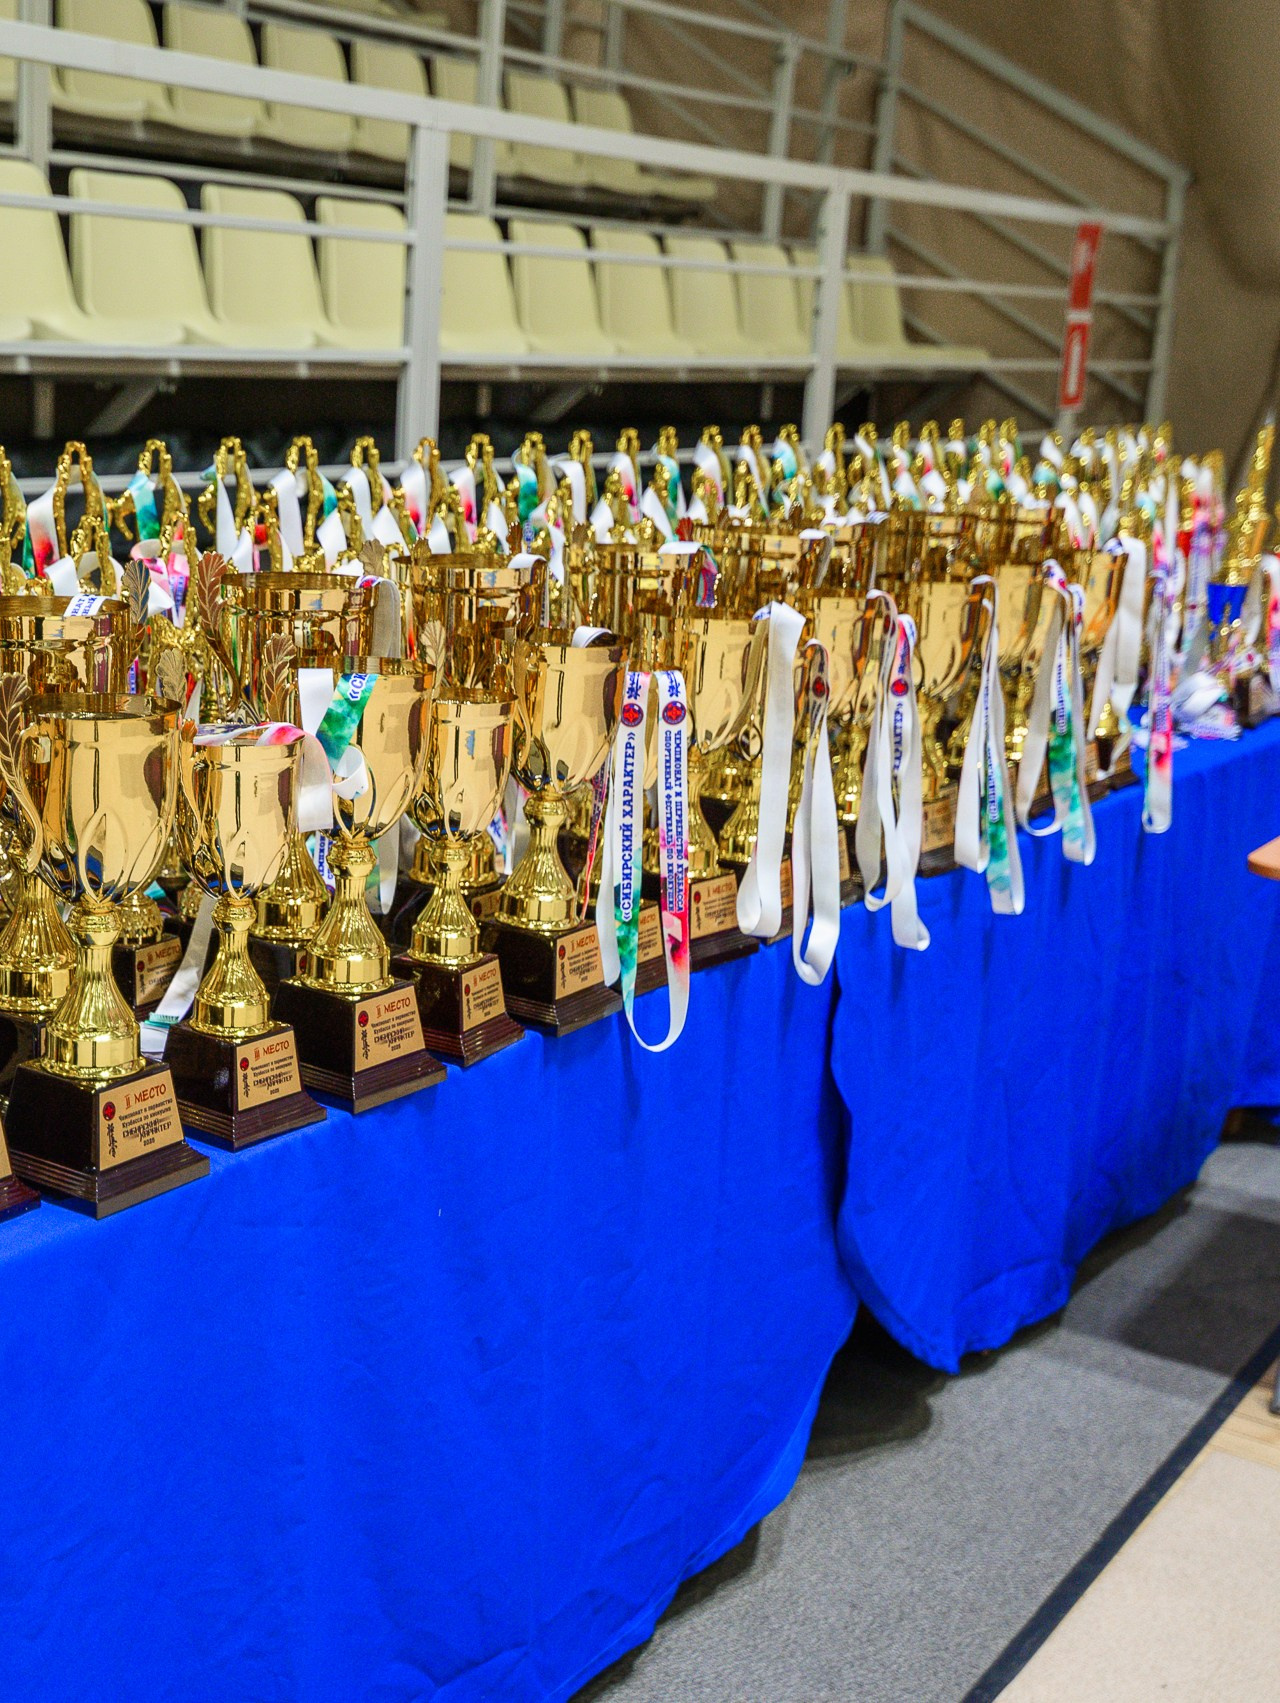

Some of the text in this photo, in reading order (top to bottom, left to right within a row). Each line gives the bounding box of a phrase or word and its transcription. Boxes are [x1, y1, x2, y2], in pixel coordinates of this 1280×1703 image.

[674, 730, 682, 788] ЧЕМПИОНАТ
[620, 732, 636, 920] «СИБИРСКИЙ ХАРАКТЕР»
[675, 801, 684, 860] ПЕРВЕНСТВО
[676, 864, 684, 912] КУЗБАССА
[384, 997, 410, 1013] МЕСТО
[263, 1040, 289, 1056] МЕСТО
[134, 1084, 166, 1104] МЕСТО
